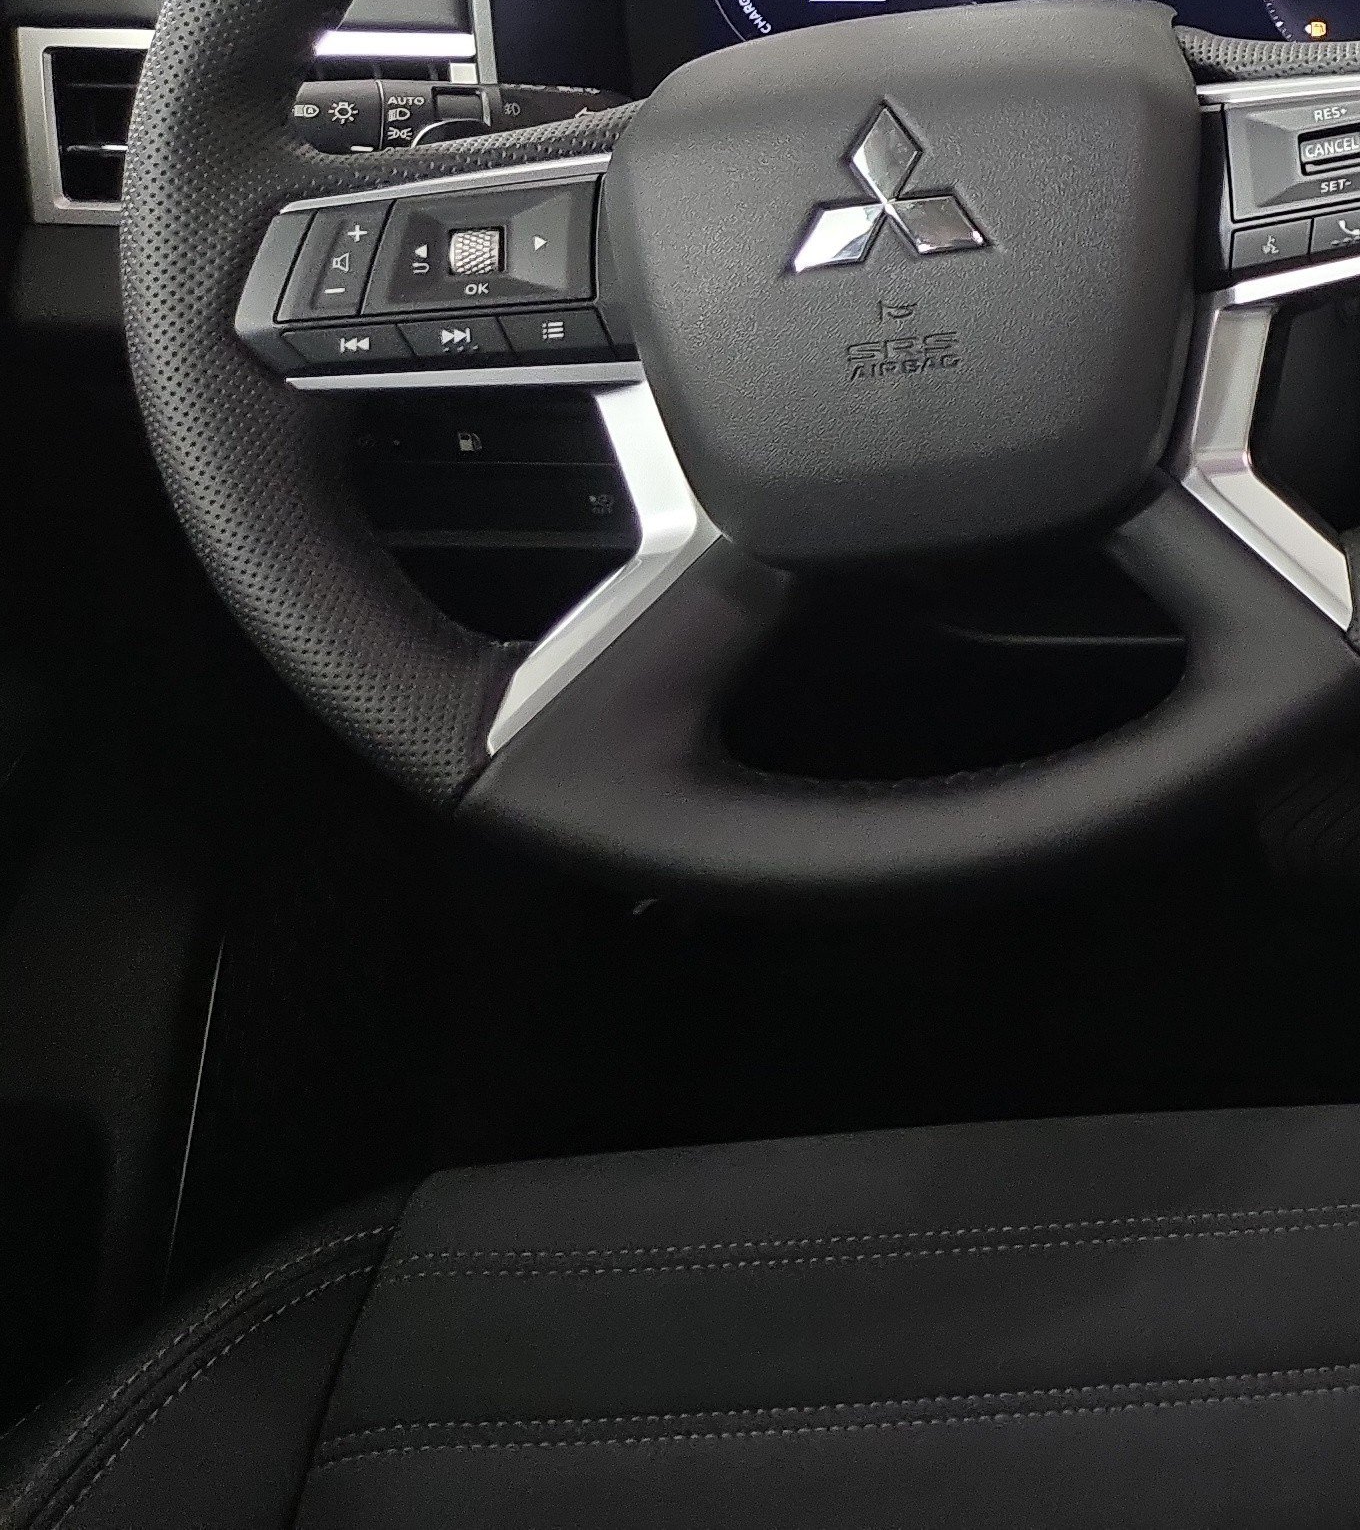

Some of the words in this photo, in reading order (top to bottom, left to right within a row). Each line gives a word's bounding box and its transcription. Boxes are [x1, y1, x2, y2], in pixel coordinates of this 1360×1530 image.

[387, 96, 425, 106] AUTO
[1304, 137, 1360, 160] CANCEL
[465, 282, 490, 296] OK
[847, 331, 958, 362] SRS
[849, 354, 961, 381] AIRBAG
